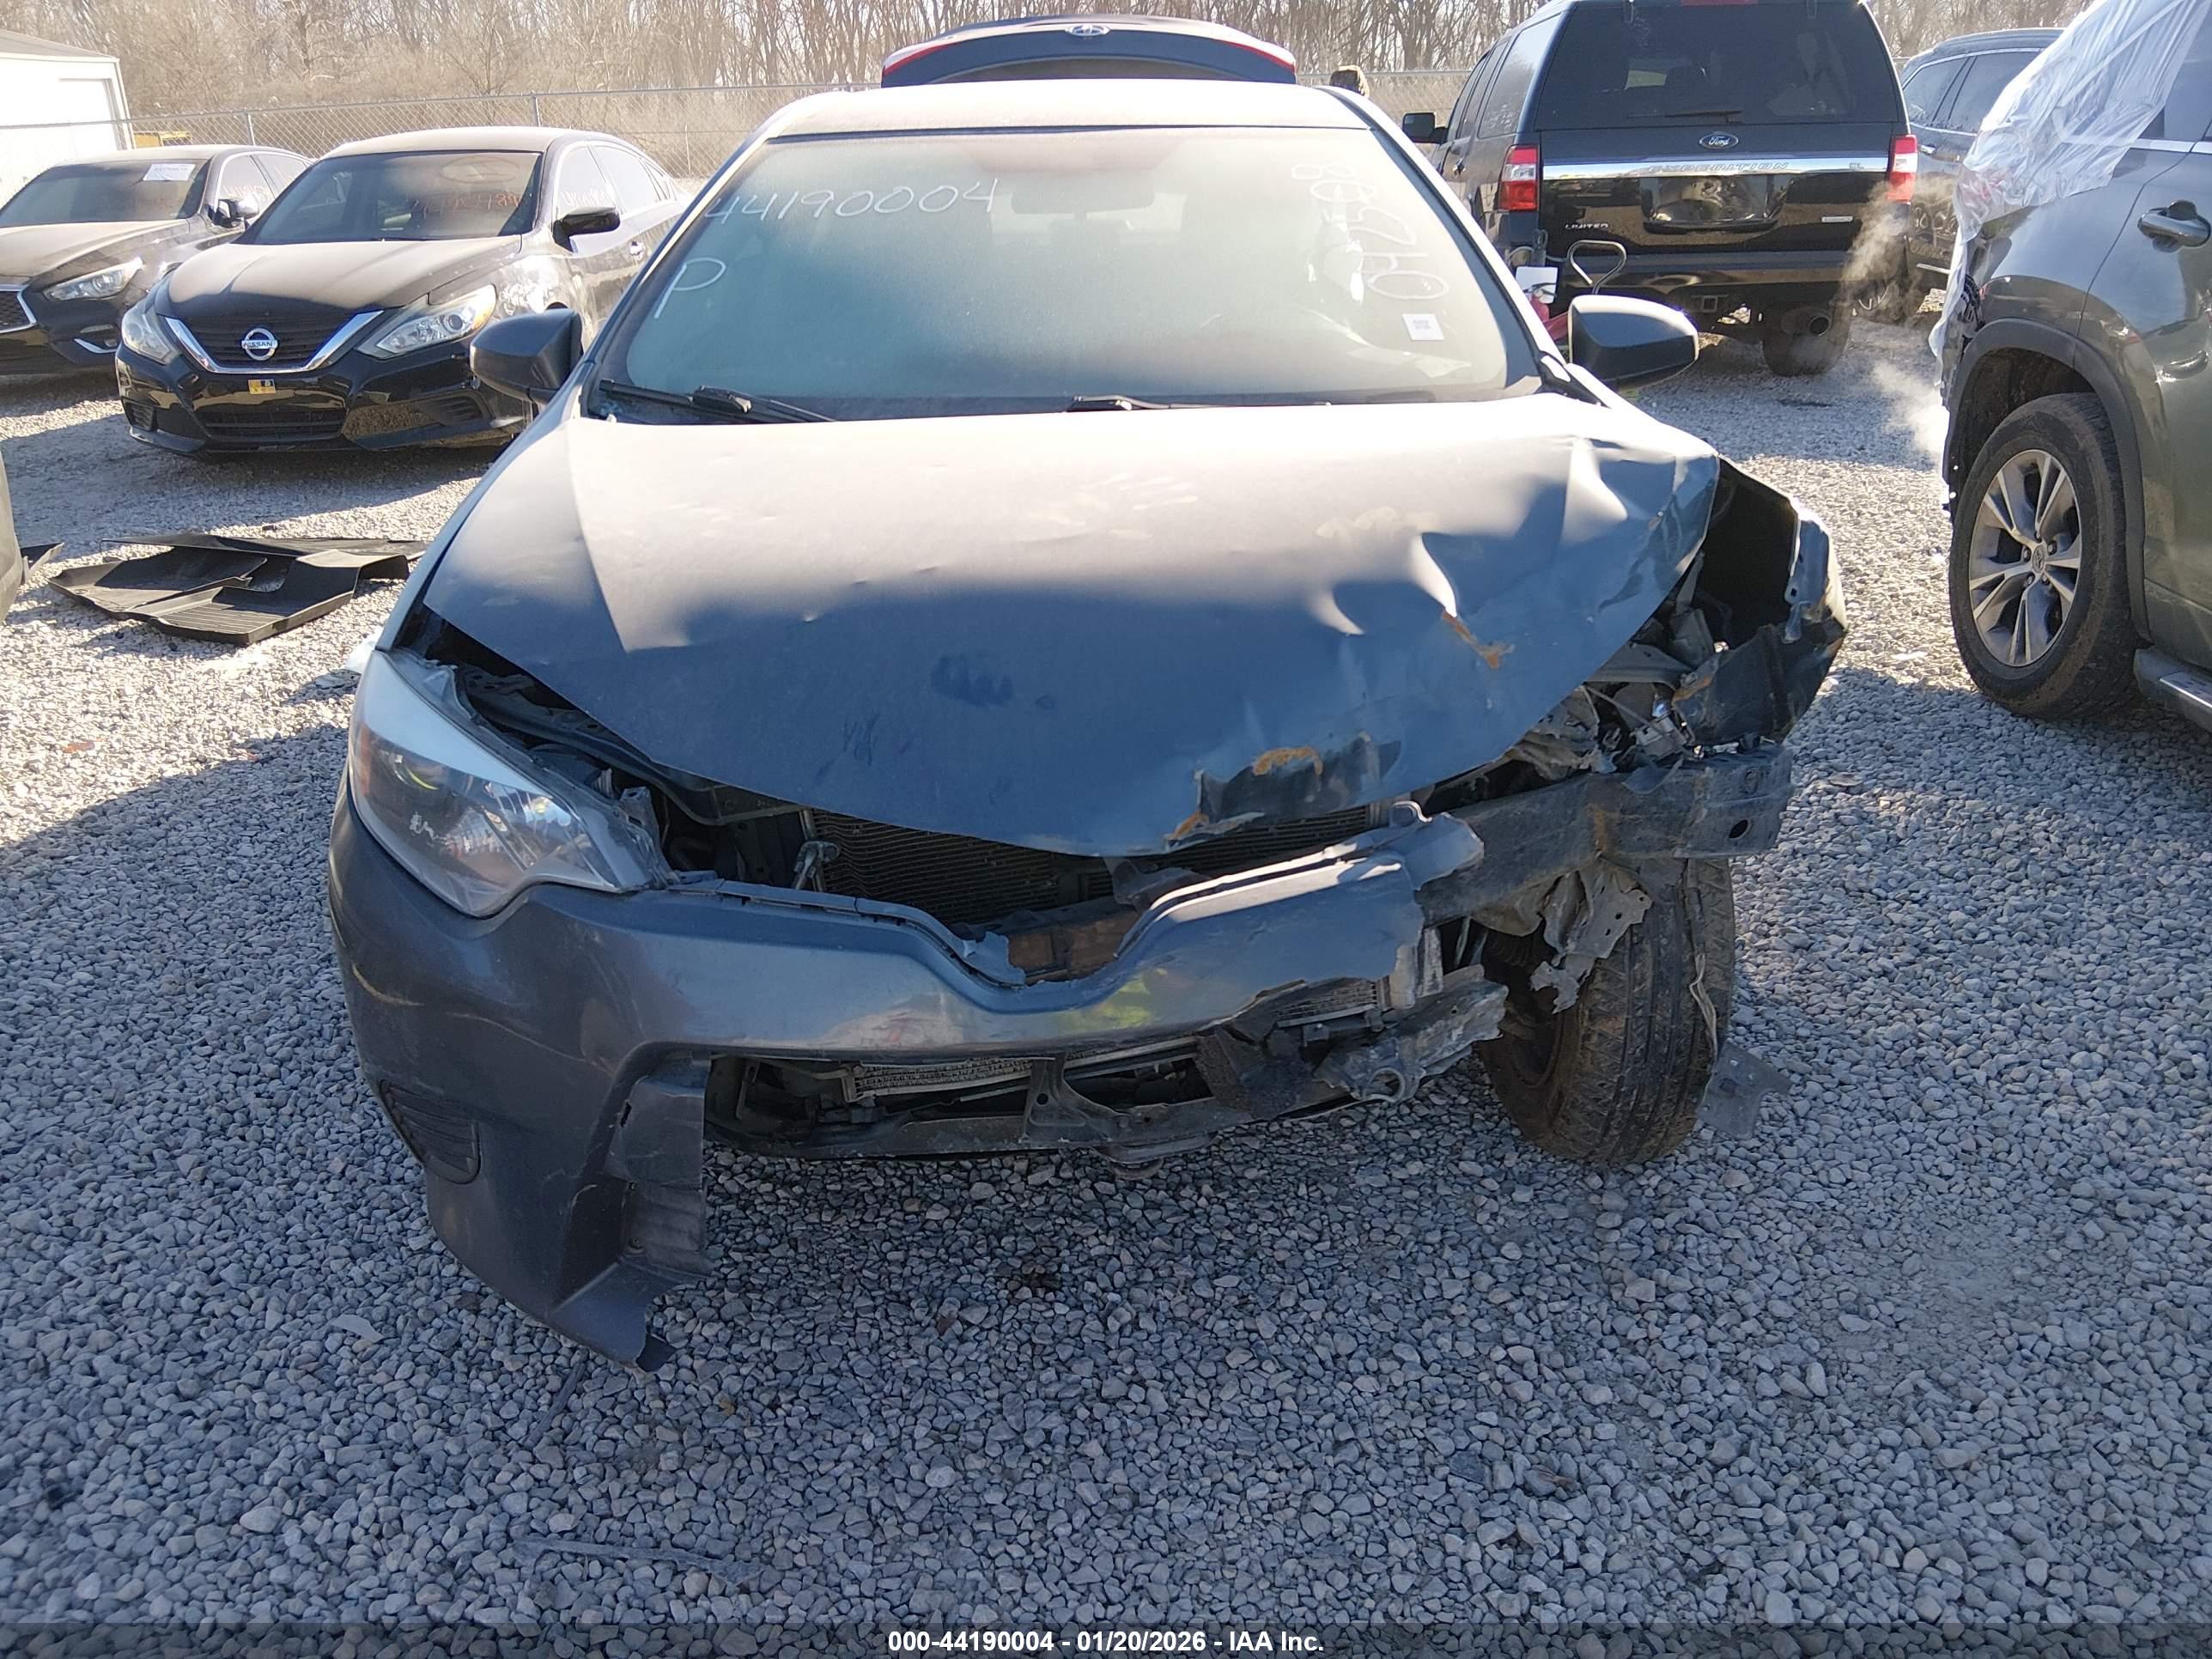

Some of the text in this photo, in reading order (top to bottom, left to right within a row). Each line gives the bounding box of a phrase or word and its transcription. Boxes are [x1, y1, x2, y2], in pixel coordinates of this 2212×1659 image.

[1649, 161, 1789, 173] EXPEDITION
[704, 177, 1000, 225] 44190004
[653, 257, 726, 320] P
